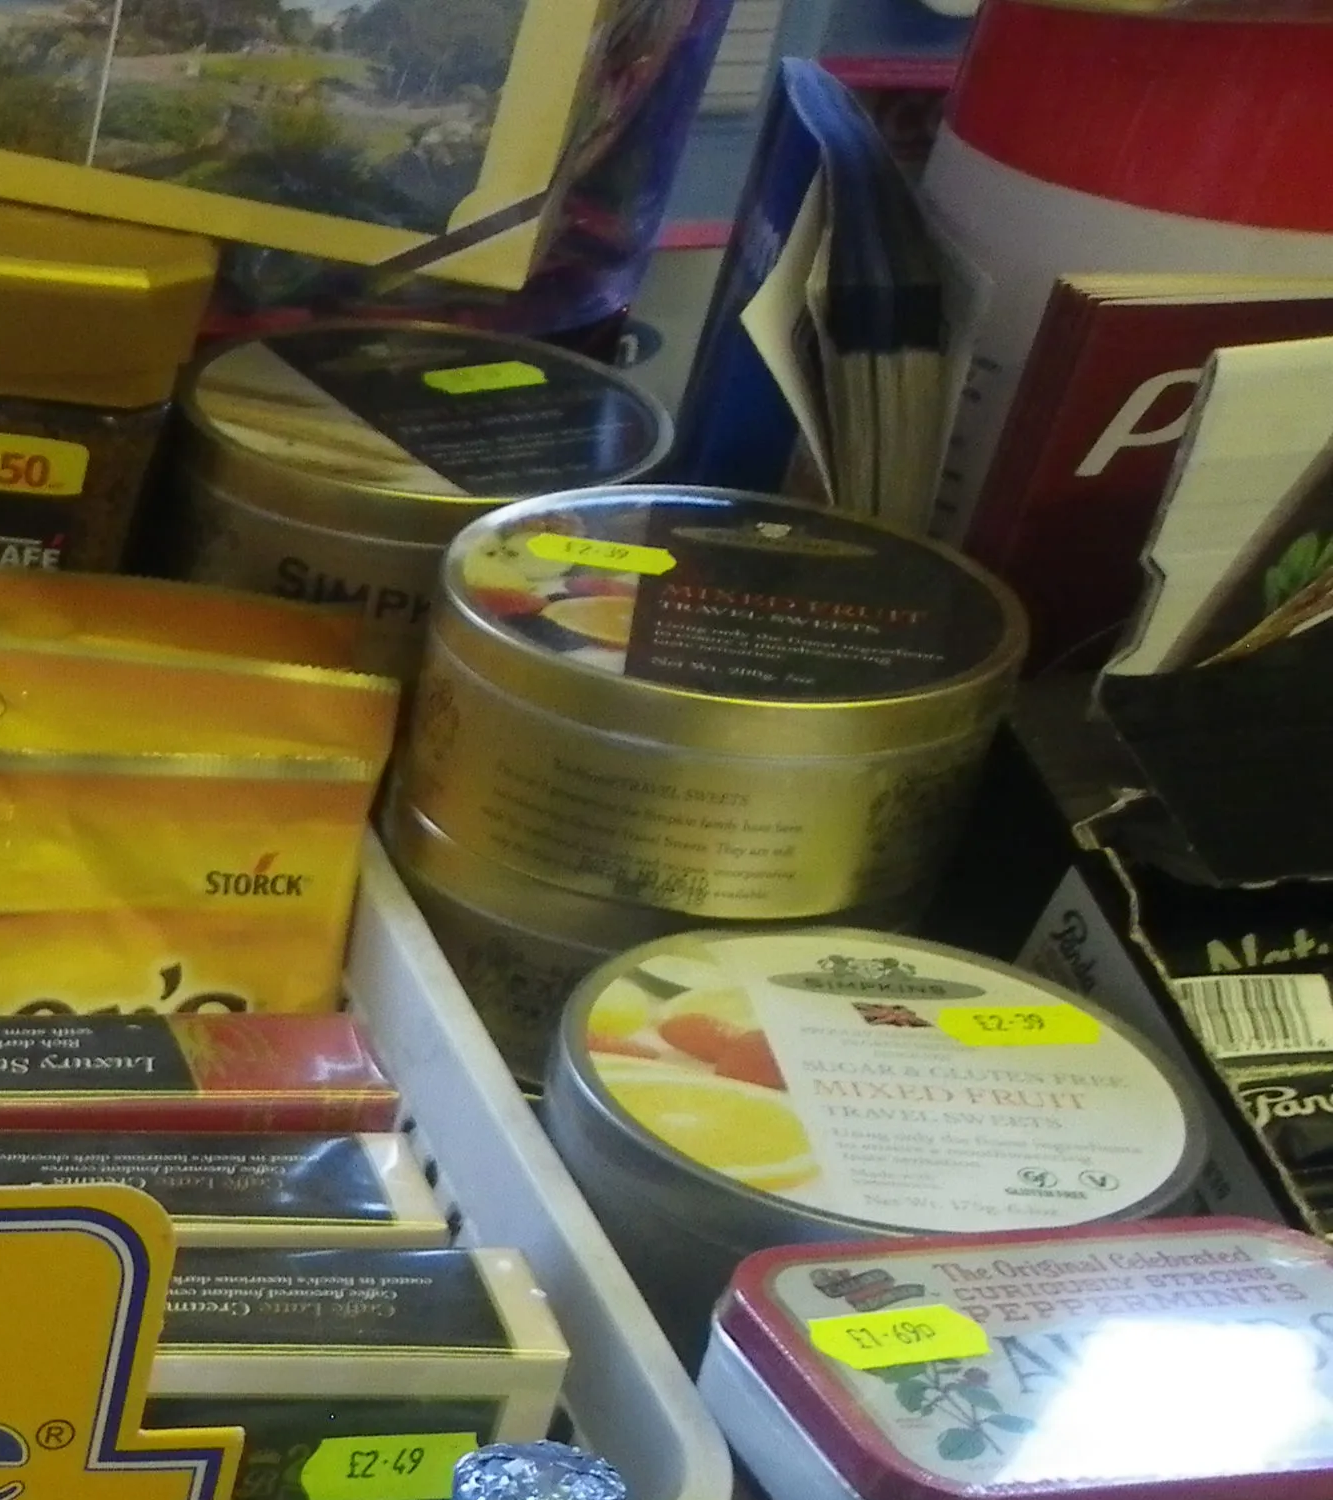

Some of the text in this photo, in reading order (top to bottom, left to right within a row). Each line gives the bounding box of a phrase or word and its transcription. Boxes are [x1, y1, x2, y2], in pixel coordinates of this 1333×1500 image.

[205, 868, 307, 899] STORCK
[3, 1027, 46, 1038] stem
[40, 1053, 157, 1074] Luxury
[812, 1077, 1087, 1112] MIXED FRUIT
[1237, 1084, 1333, 1129] Pan
[935, 1245, 1254, 1284] The Original Celebrated
[952, 1265, 1279, 1303] CURIOUSLY STRONG
[960, 1282, 1310, 1325] PEPPERMINTS
